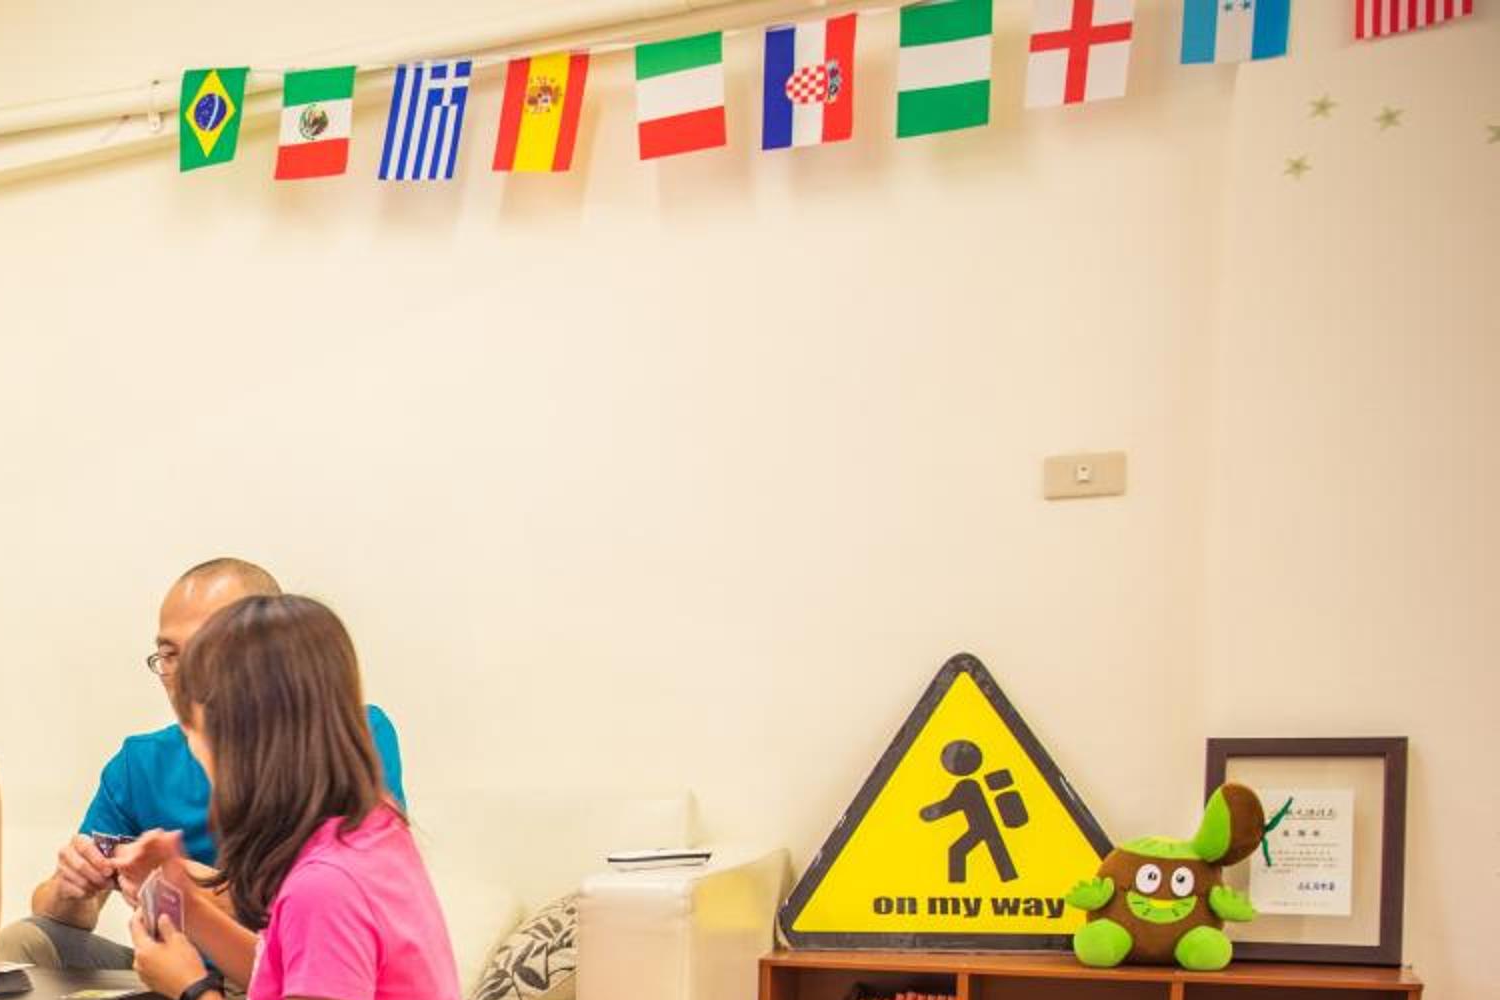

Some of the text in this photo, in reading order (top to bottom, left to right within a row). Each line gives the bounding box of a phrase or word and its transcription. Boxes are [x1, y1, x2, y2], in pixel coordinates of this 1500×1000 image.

[873, 896, 1065, 919] on my way
